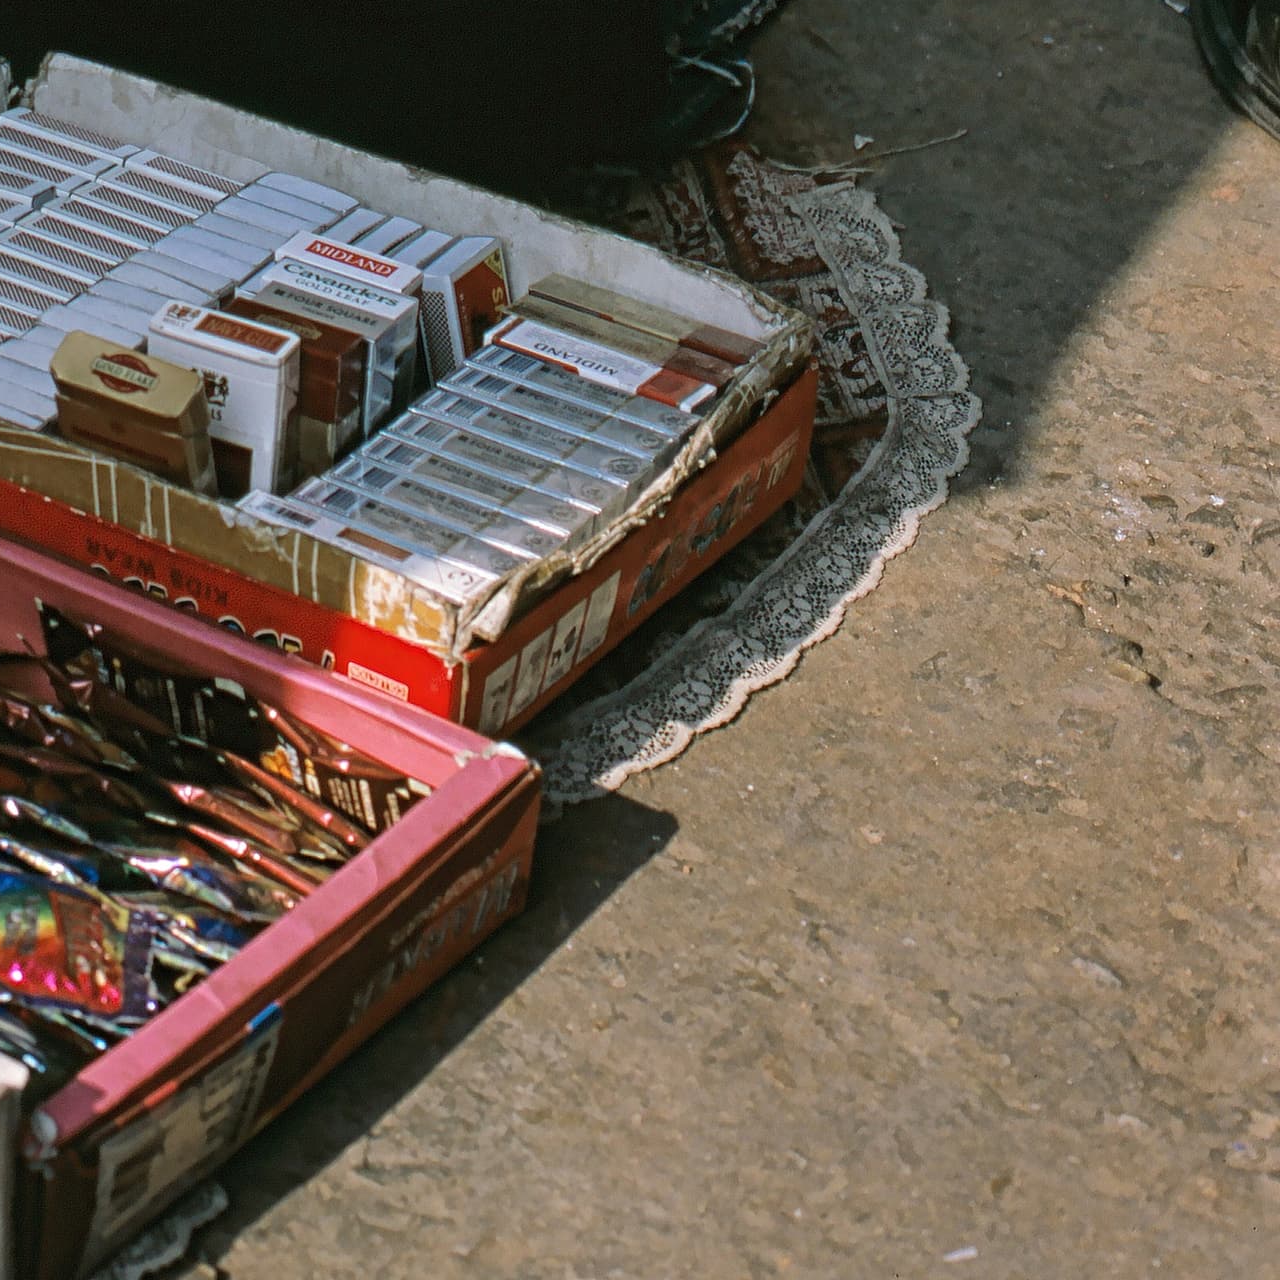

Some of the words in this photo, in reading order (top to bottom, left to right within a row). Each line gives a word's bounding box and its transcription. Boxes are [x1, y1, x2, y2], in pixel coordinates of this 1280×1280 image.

[311, 241, 392, 276] MIDLAND
[283, 263, 399, 307] Cavanders
[295, 278, 336, 295] GOLD
[336, 288, 369, 306] LEAF
[284, 291, 324, 308] FOUR
[326, 304, 378, 327] SQUARE
[533, 342, 619, 376] MIDLAND
